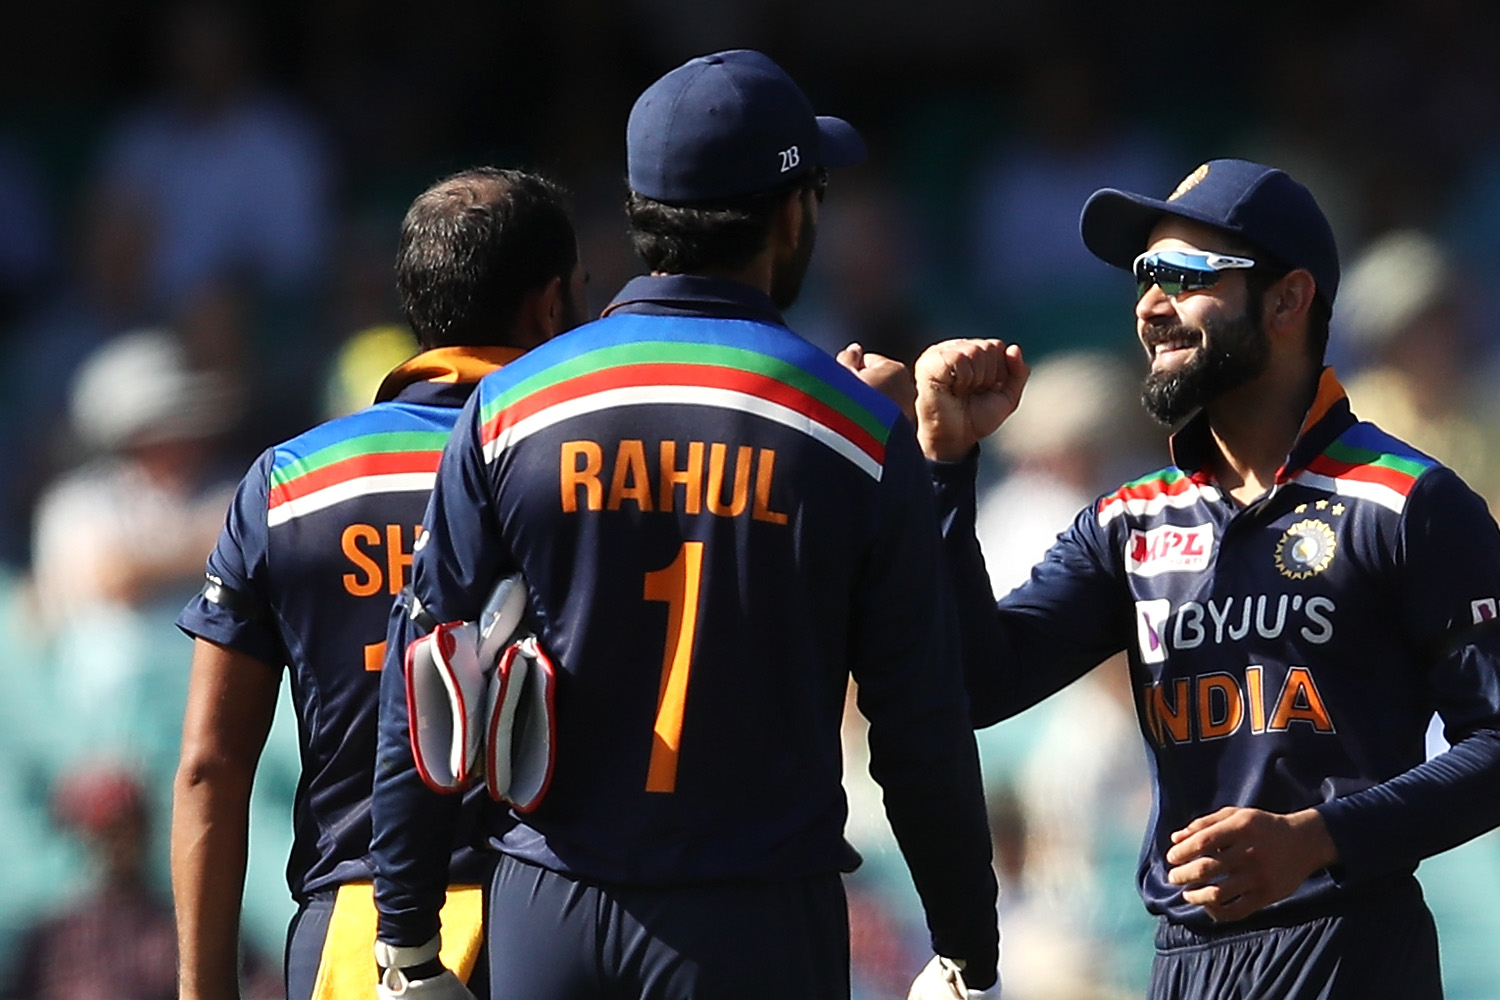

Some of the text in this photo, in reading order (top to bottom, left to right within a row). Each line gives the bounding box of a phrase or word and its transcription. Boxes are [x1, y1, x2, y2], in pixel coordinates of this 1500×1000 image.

[560, 439, 789, 525] RAHUL
[1131, 531, 1204, 562] MPL
[1173, 595, 1336, 649] BYJU'S
[643, 541, 703, 793] 1
[1144, 665, 1337, 748] INDIA
